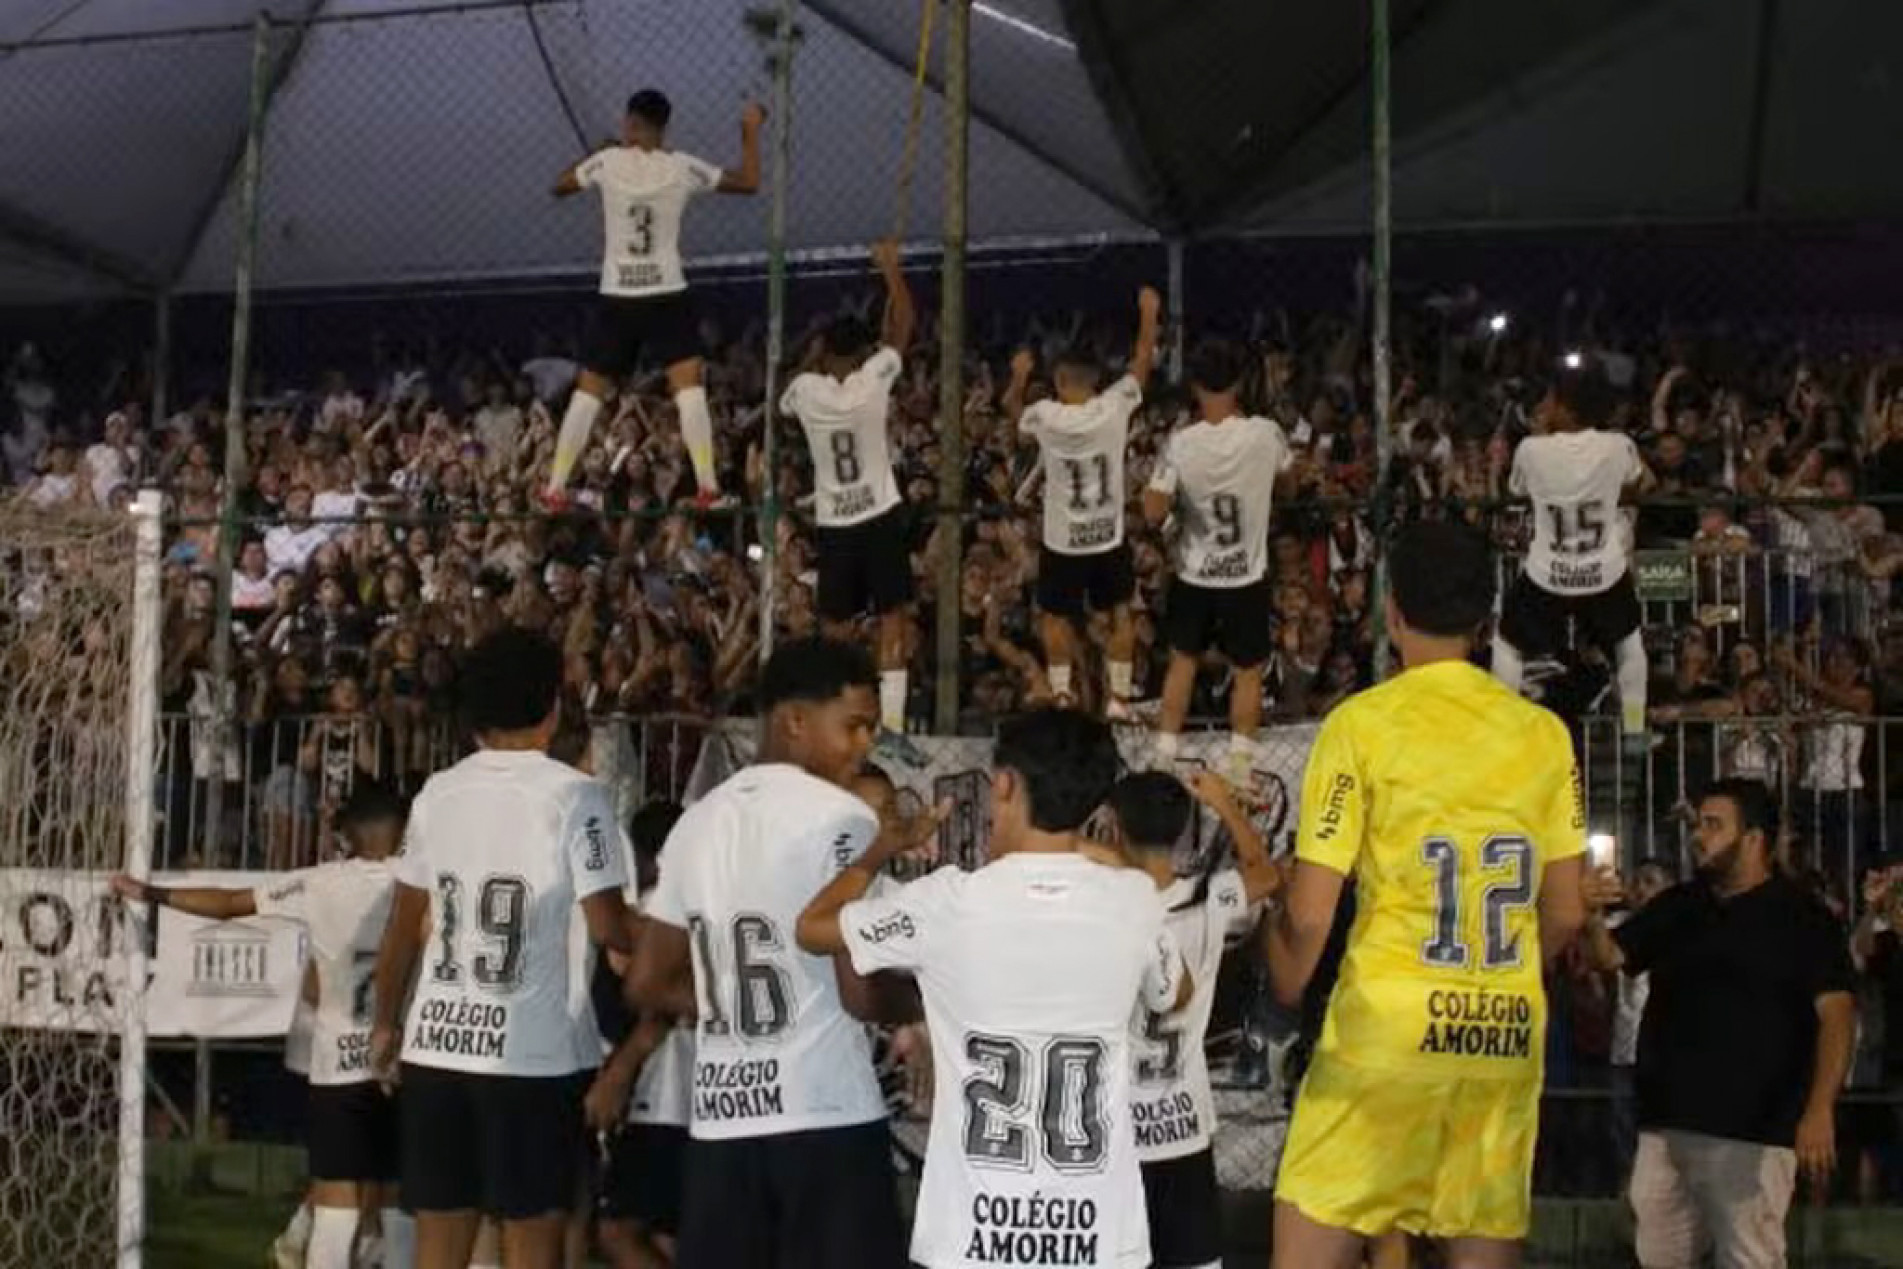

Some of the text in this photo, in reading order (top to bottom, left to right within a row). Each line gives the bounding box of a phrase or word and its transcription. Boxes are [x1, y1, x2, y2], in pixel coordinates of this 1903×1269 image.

[628, 202, 654, 256] 3
[831, 430, 860, 484] 8
[1063, 454, 1113, 511] 11
[1212, 494, 1241, 545] 9
[1547, 501, 1605, 553] 15
[1421, 833, 1537, 970] 12
[432, 870, 530, 990] 19
[687, 911, 795, 1042] 16
[419, 997, 507, 1029] COLÉGIO
[1428, 985, 1531, 1023] COLÉGIO
[410, 1026, 507, 1058] AMORIM
[1419, 1025, 1531, 1058] AMORIM
[962, 1031, 1110, 1175] 20
[973, 1190, 1097, 1230] COLÉGIO
[965, 1231, 1098, 1266] AMORIM
